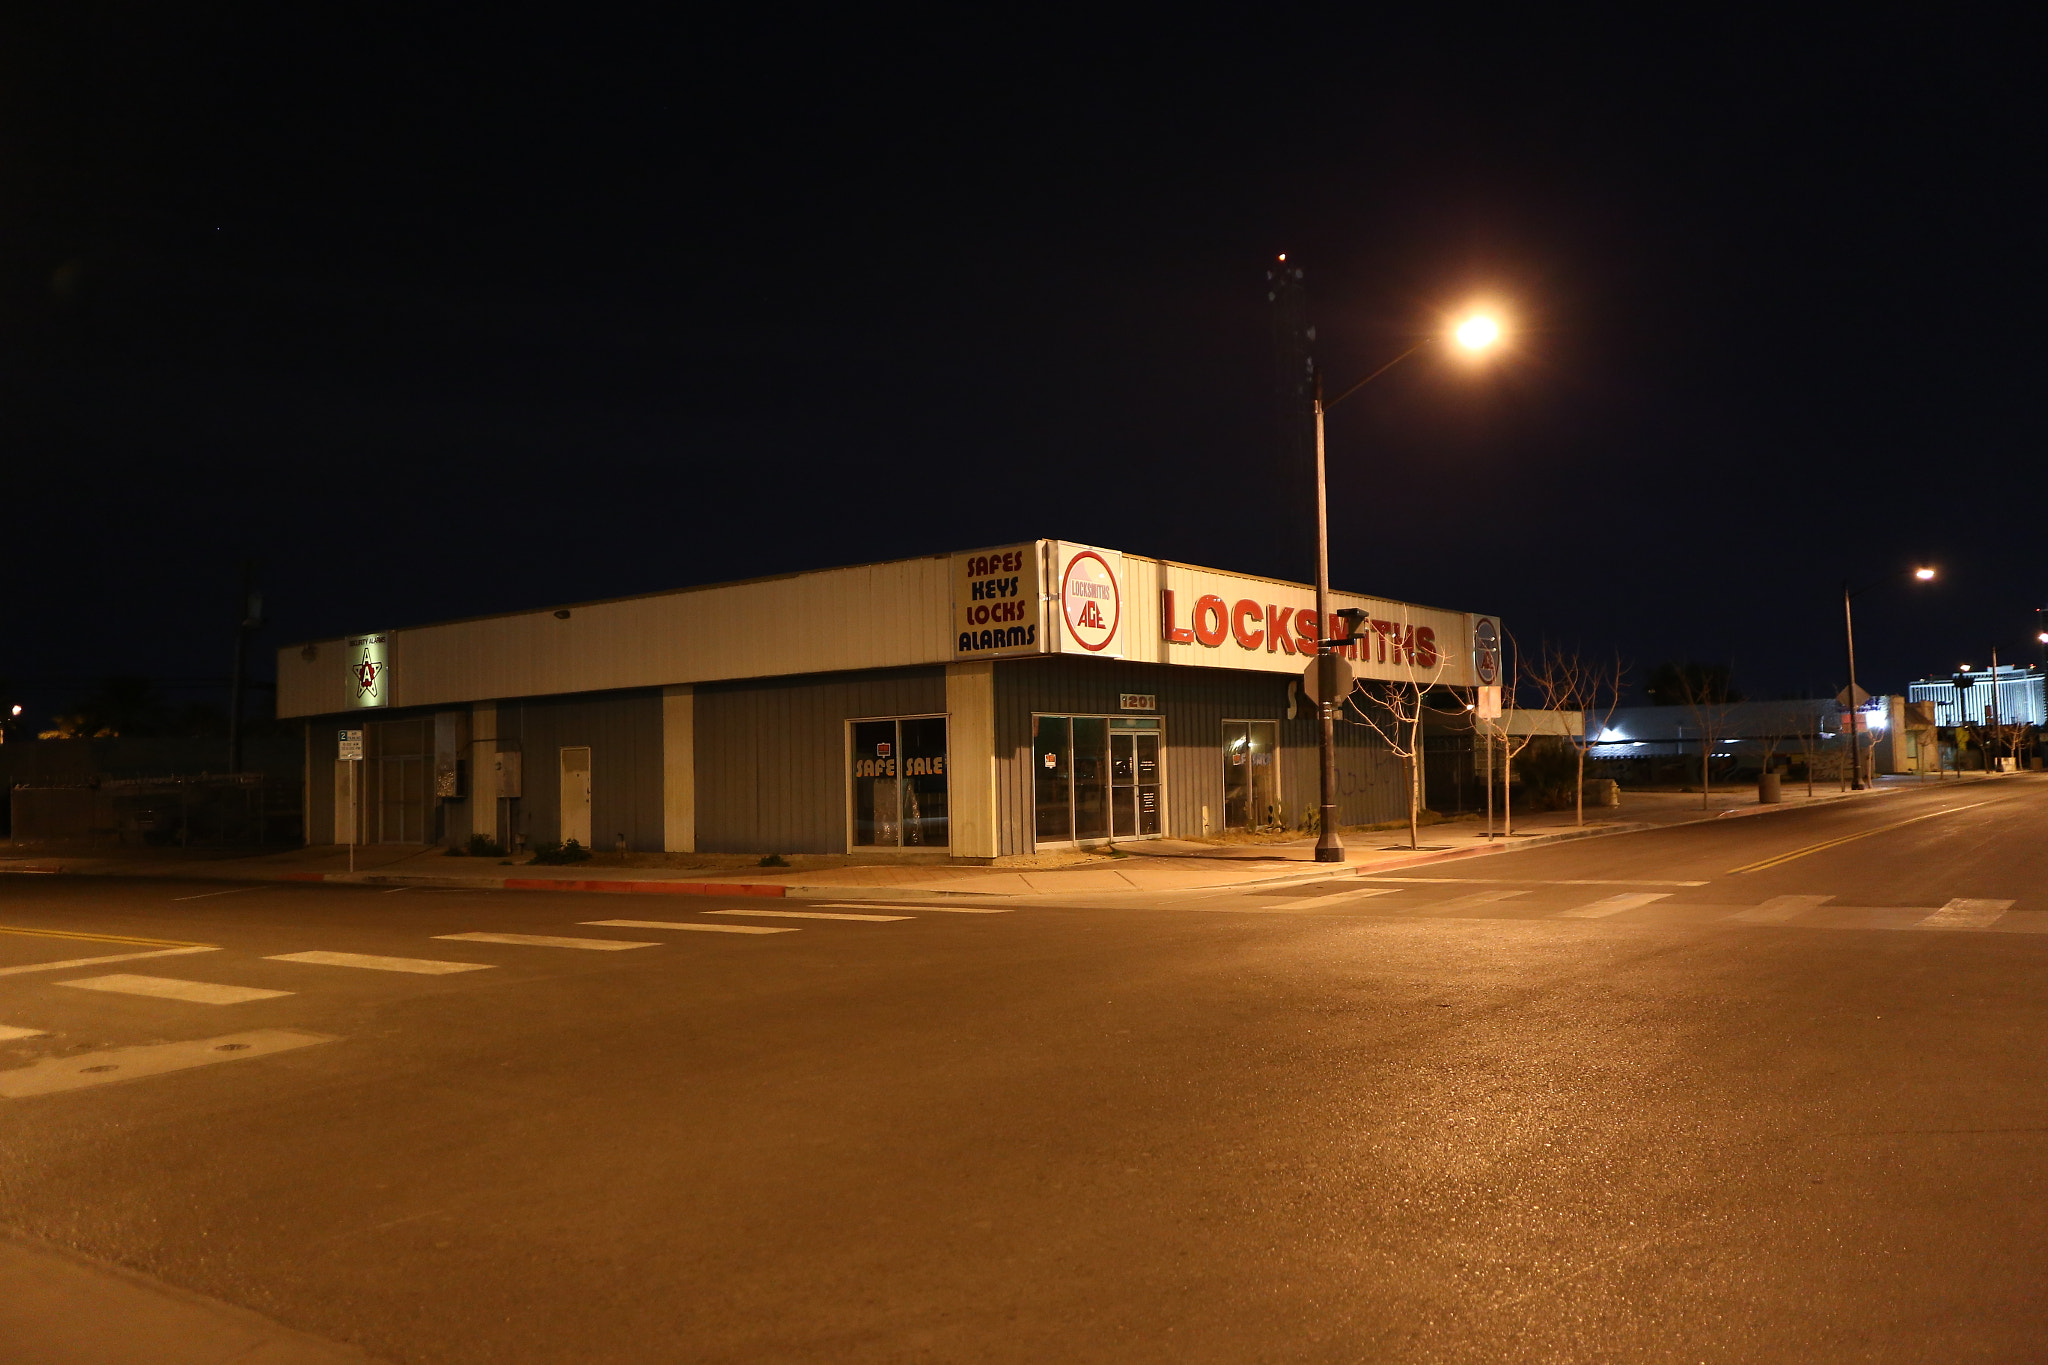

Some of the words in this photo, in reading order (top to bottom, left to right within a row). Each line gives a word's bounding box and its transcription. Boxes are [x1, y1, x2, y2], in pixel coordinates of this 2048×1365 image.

[967, 550, 1023, 577] SAFES
[971, 576, 1019, 601] KEYS
[1071, 579, 1111, 600] LOCKSMITHS
[966, 600, 1026, 626] LOCKS
[1077, 600, 1107, 630] ACE
[958, 624, 1036, 652] ALARMS
[1122, 696, 1154, 709] 1201
[856, 758, 895, 777] SAFE
[906, 757, 943, 776] SALE
